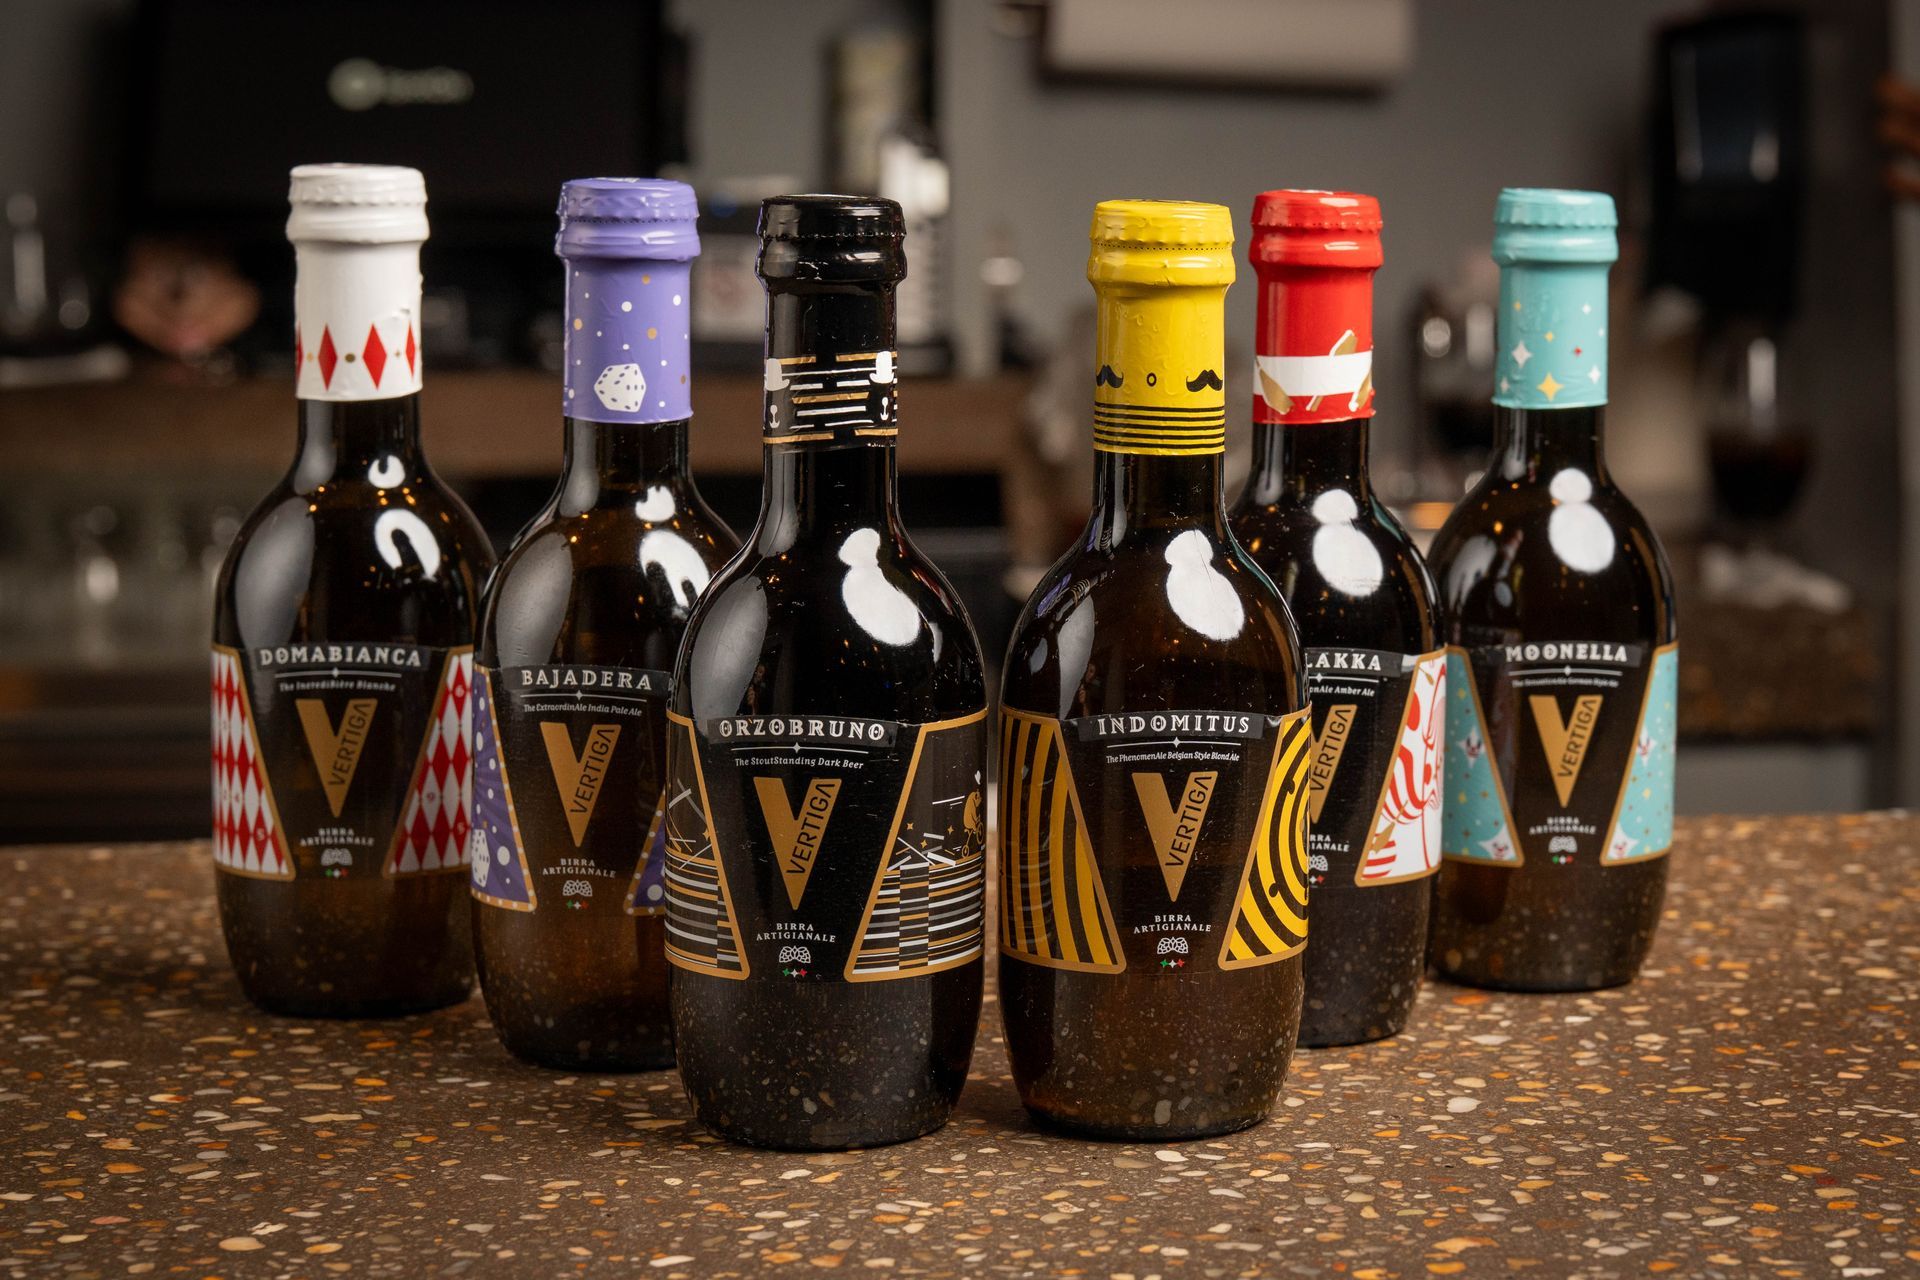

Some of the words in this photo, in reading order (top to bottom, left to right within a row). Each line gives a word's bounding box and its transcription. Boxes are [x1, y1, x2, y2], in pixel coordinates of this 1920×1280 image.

[260, 646, 421, 667] DOMABIANCA
[1505, 643, 1627, 662] MOONELLA
[521, 669, 652, 690] BAJADERA
[280, 683, 294, 692] The
[1334, 686, 1361, 695] Amber
[1361, 688, 1376, 697] Ale
[524, 704, 535, 712] The
[536, 703, 587, 712] ExtraordinAle
[588, 704, 609, 713] India
[610, 705, 629, 715] Pale
[629, 707, 642, 716] Ale
[719, 719, 885, 741] ORZOBRUNO
[1098, 715, 1250, 735] INDOMITUS
[1557, 700, 1597, 777] VERTIGA
[328, 703, 371, 787] VERTIGA
[1310, 709, 1352, 791] VERTIGA
[735, 758, 749, 767] The
[750, 756, 816, 767] StoutStanding
[817, 757, 840, 767] Dark
[842, 759, 864, 770] Beer
[1106, 755, 1118, 764] The
[1119, 752, 1167, 762] PhenomenAle
[1167, 752, 1194, 761] Belgian
[1194, 751, 1211, 761] Style
[1211, 752, 1231, 761] Blond
[1230, 753, 1240, 762] Ale
[569, 729, 615, 814] VERTIGA
[1165, 776, 1212, 866] VERTIGA
[1547, 816, 1580, 825] BIRRA
[318, 827, 355, 837] BIRRA
[786, 783, 835, 874] VERTIGA
[1529, 824, 1597, 835] ARTIGIANALE
[299, 836, 375, 847] ARTIGIANALE
[1310, 834, 1331, 842] RRA
[1311, 842, 1350, 852] IANALE
[560, 858, 595, 867] BIRRA
[542, 866, 616, 878] ARTIGIANALE
[1154, 914, 1191, 923] BIRRA
[776, 922, 814, 931] BIRRA
[1133, 923, 1212, 934] ARTIGIANALE
[756, 931, 836, 943] ARTIGIANALE
